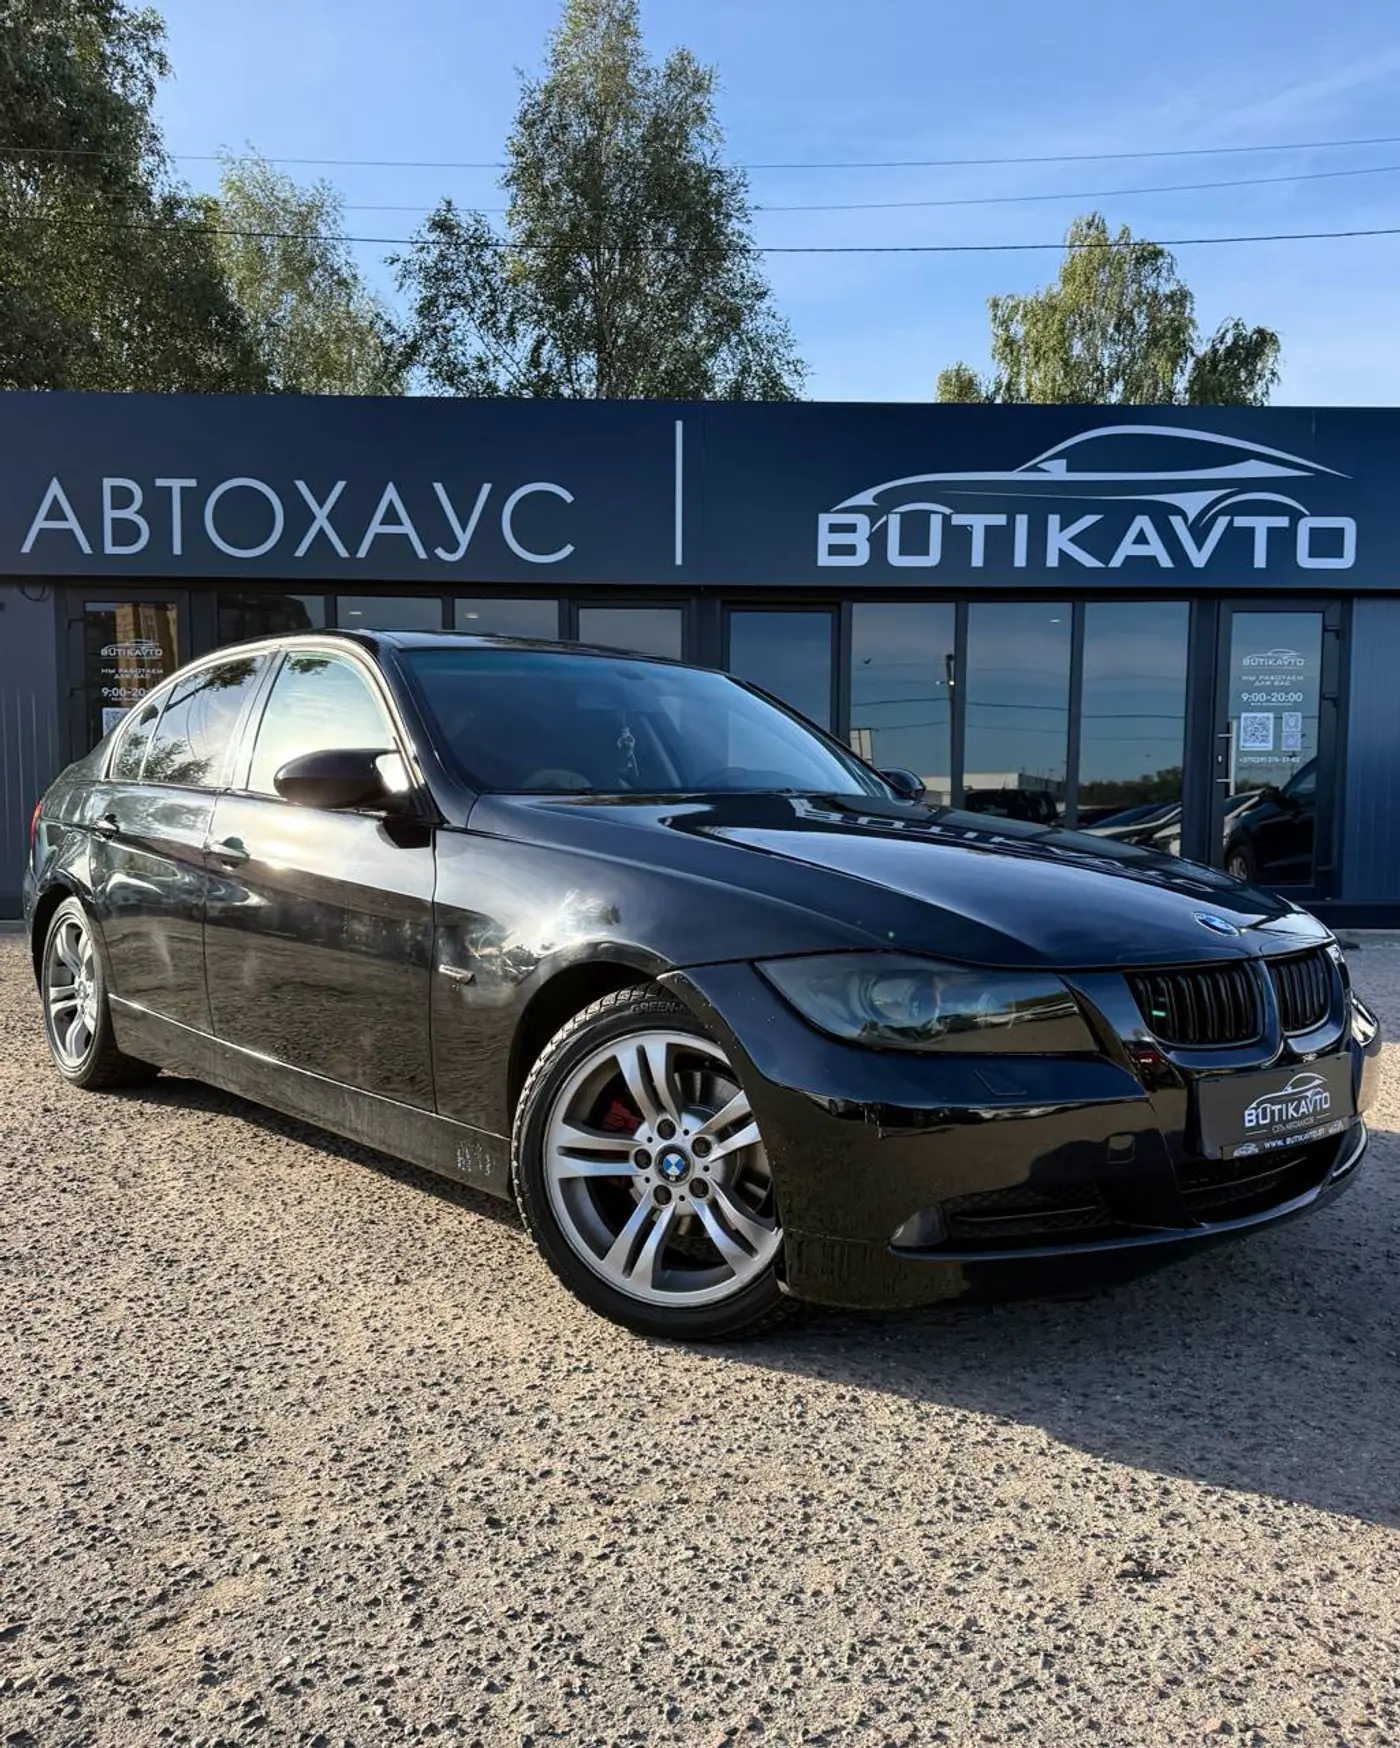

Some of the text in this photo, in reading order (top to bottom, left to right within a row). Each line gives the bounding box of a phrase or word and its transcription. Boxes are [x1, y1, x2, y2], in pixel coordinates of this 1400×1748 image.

[20, 476, 576, 564] АВТОХАУС
[816, 512, 1357, 569] BUTIKAVTO
[1242, 658, 1304, 666] BUTIKAVTO
[1241, 692, 1304, 702] 9:00-20:00
[1244, 1092, 1331, 1127] BUTIKAVTO
